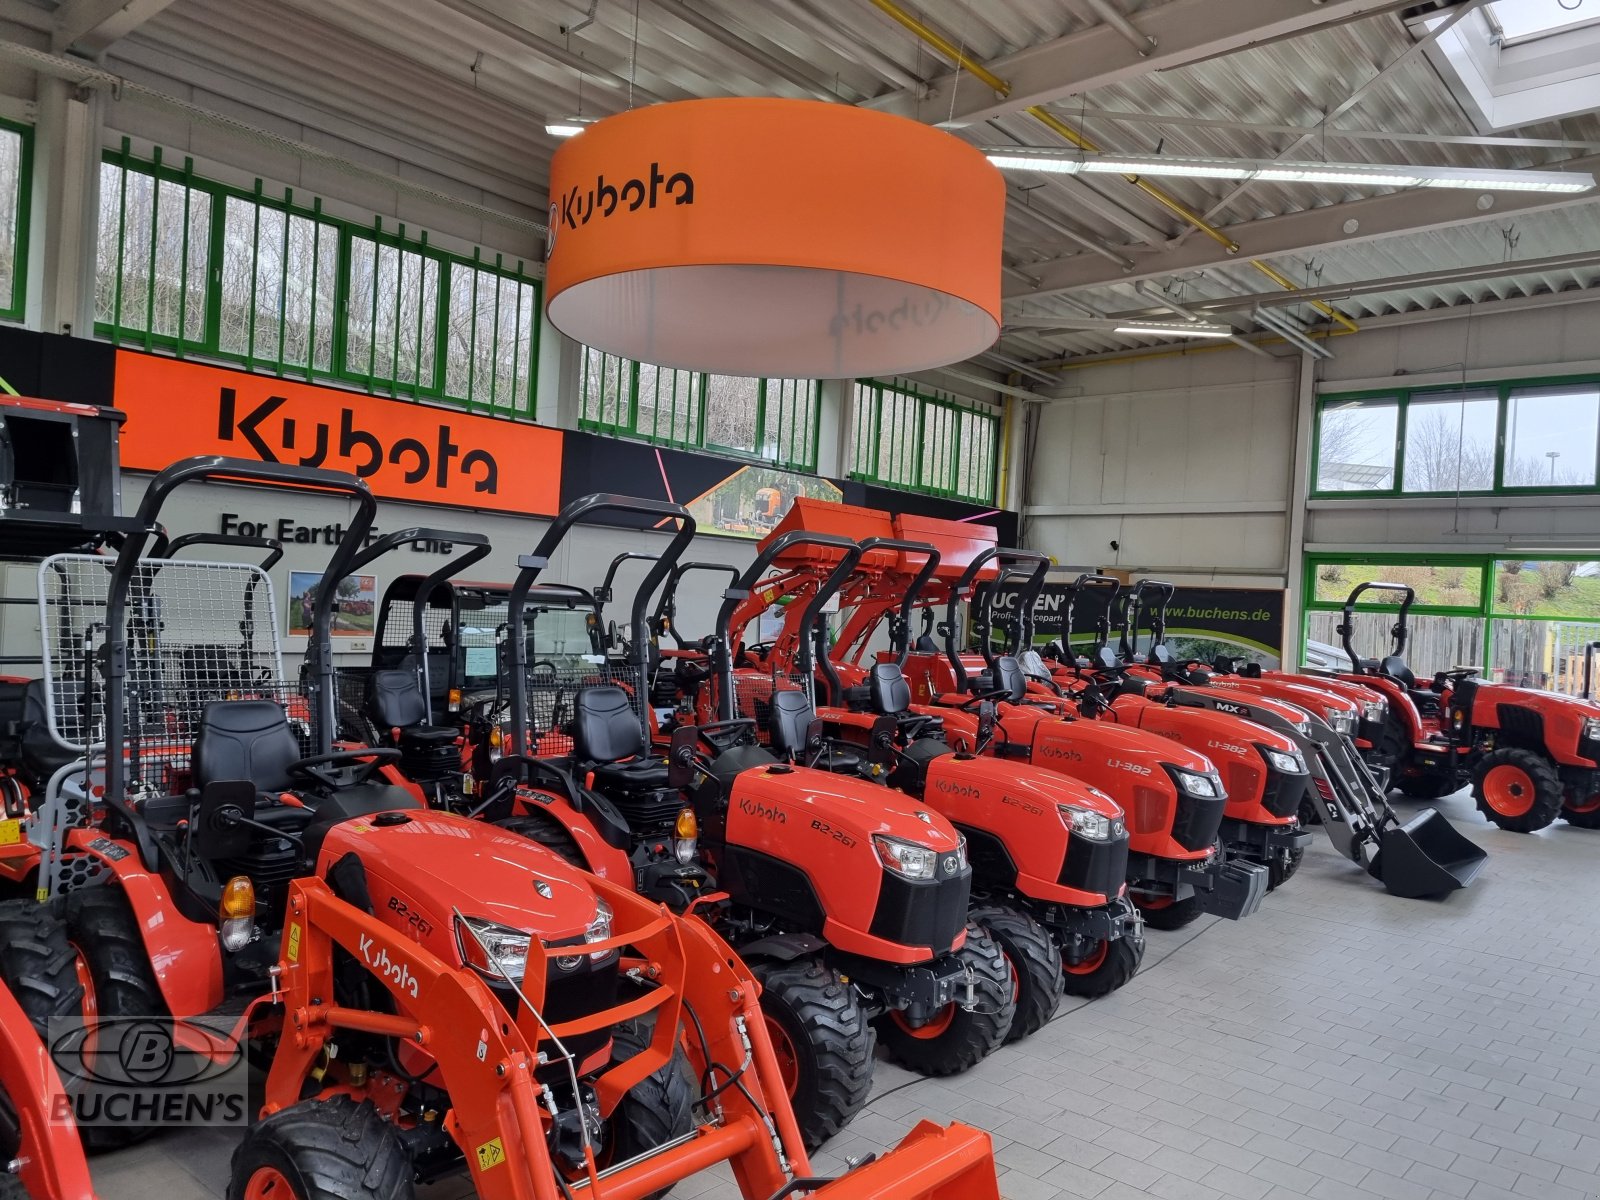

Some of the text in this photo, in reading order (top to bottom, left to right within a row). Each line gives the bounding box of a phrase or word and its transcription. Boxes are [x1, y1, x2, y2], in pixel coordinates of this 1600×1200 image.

[561, 162, 695, 230] Kubota
[217, 387, 498, 495] Kubota
[220, 513, 268, 538] For
[276, 518, 348, 546] Earth
[1209, 680, 1240, 689] Kubota
[1216, 702, 1240, 714] MX
[1039, 745, 1083, 762] Kubota
[935, 779, 981, 799] Kubota
[739, 797, 786, 825] Kubota
[1001, 795, 1044, 816] B2-261
[810, 819, 857, 849] B2-261
[387, 896, 435, 937] B2-261
[359, 932, 419, 999] Kubota
